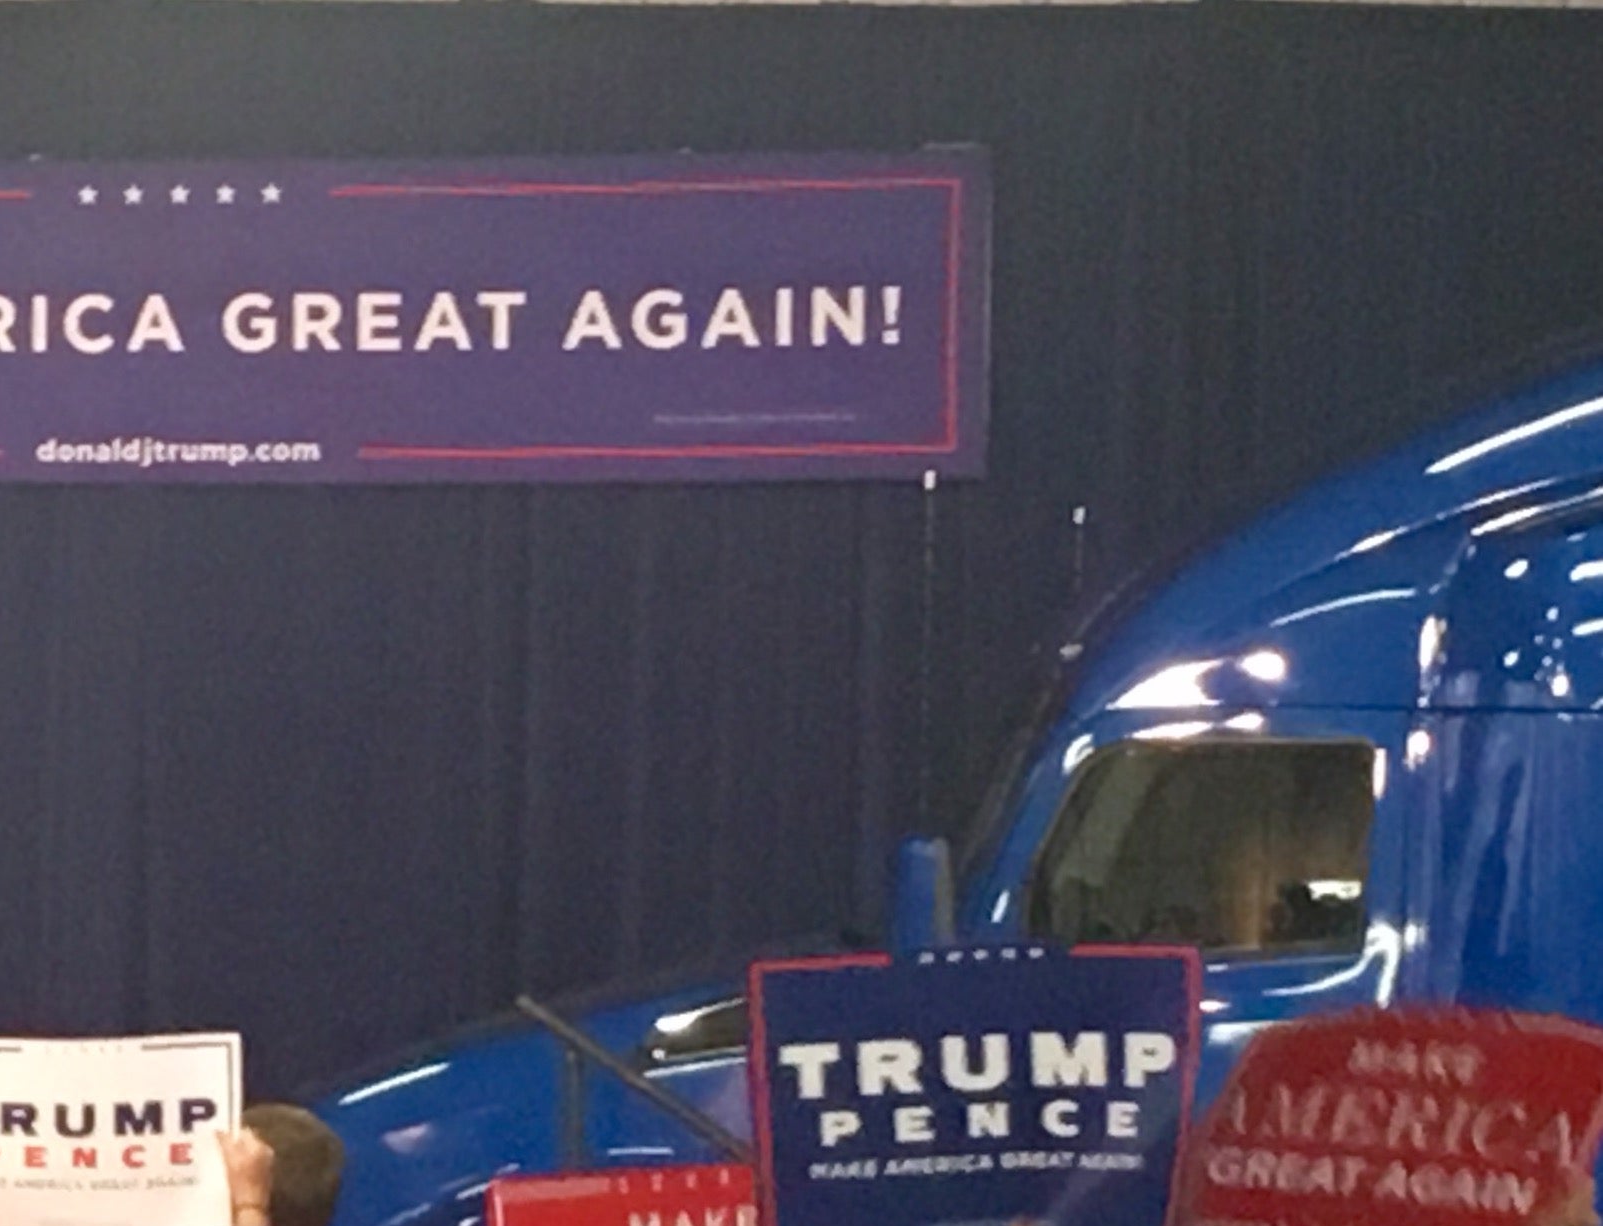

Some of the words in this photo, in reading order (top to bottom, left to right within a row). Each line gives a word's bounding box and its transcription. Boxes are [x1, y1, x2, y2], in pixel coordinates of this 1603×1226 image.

[220, 290, 528, 353] GREAT
[561, 285, 902, 350] AGAIN!
[34, 437, 321, 467] donaldjtrump.com
[779, 1032, 1176, 1099] TRUMP
[819, 1100, 1141, 1147] PENCE
[1207, 1145, 1366, 1197] GREAT
